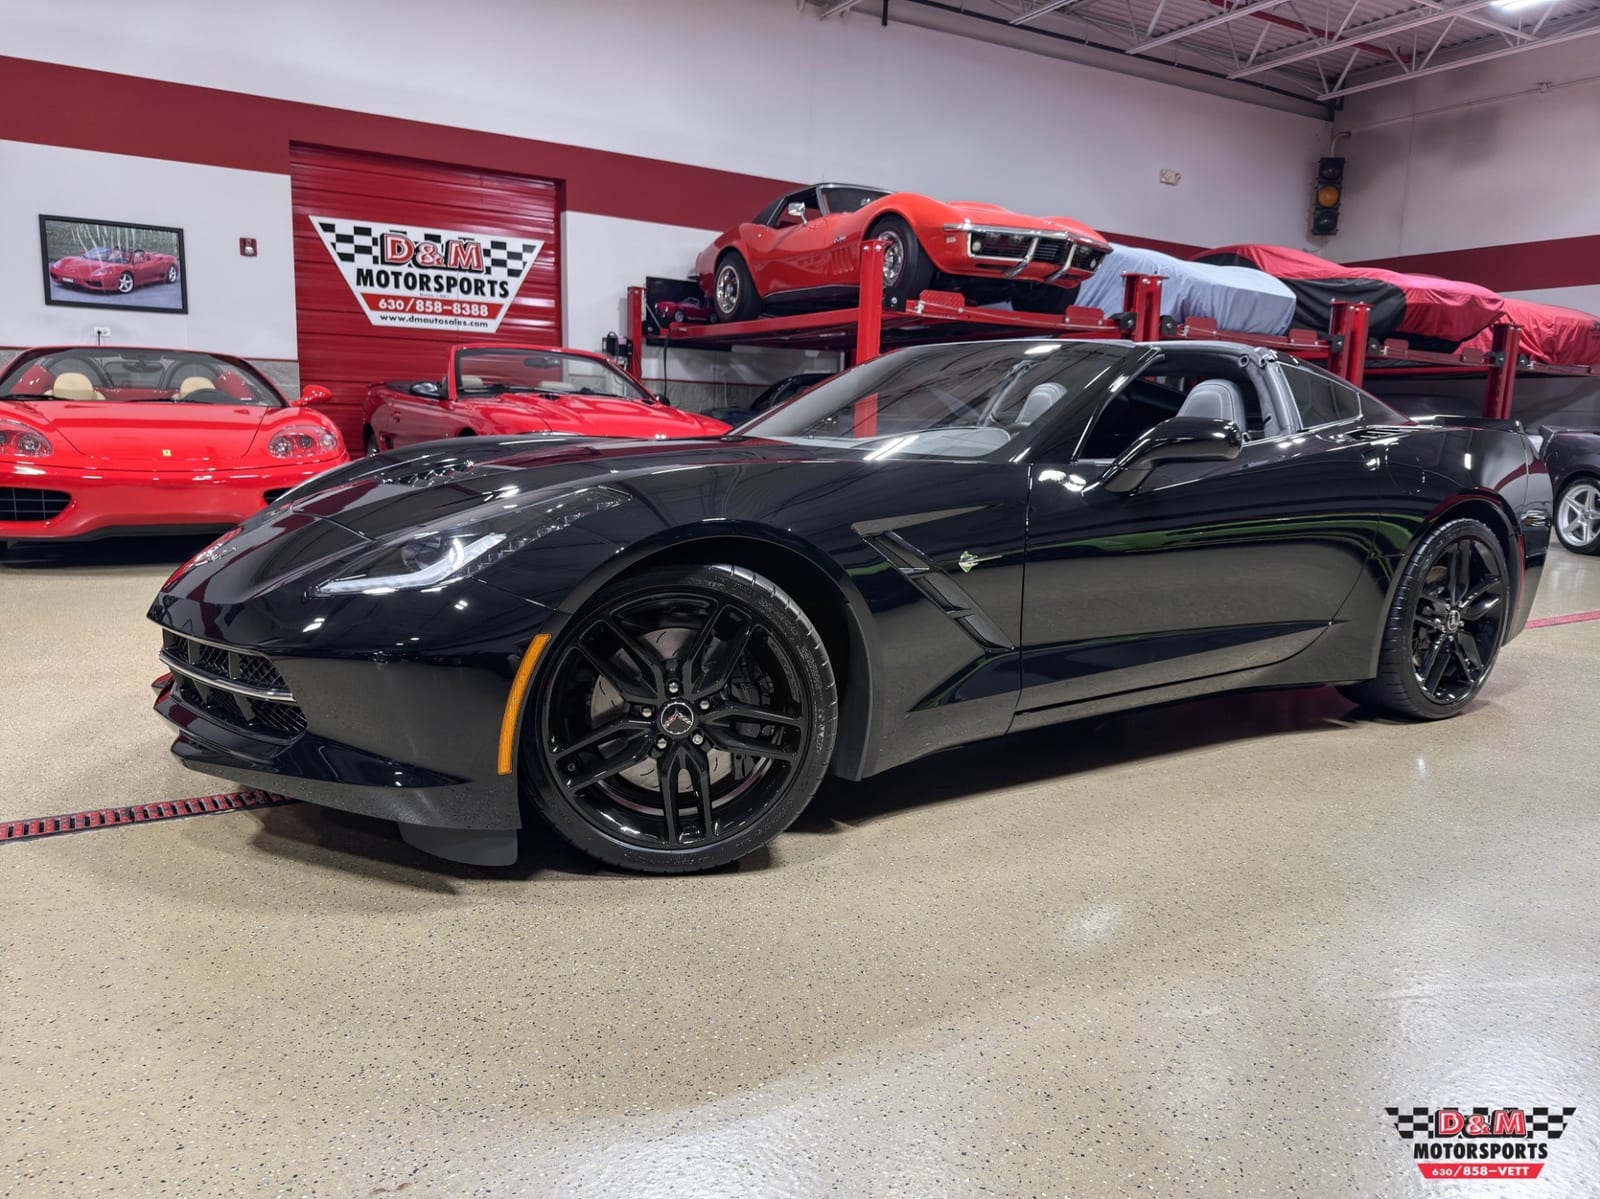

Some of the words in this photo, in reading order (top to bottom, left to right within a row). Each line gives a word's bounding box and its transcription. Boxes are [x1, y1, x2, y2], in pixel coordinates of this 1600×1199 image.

[382, 233, 484, 273] D&M
[356, 268, 509, 297] MOTORSPORTS
[378, 298, 488, 317] 630/858-8388
[380, 314, 488, 328] www.dmautosales.com
